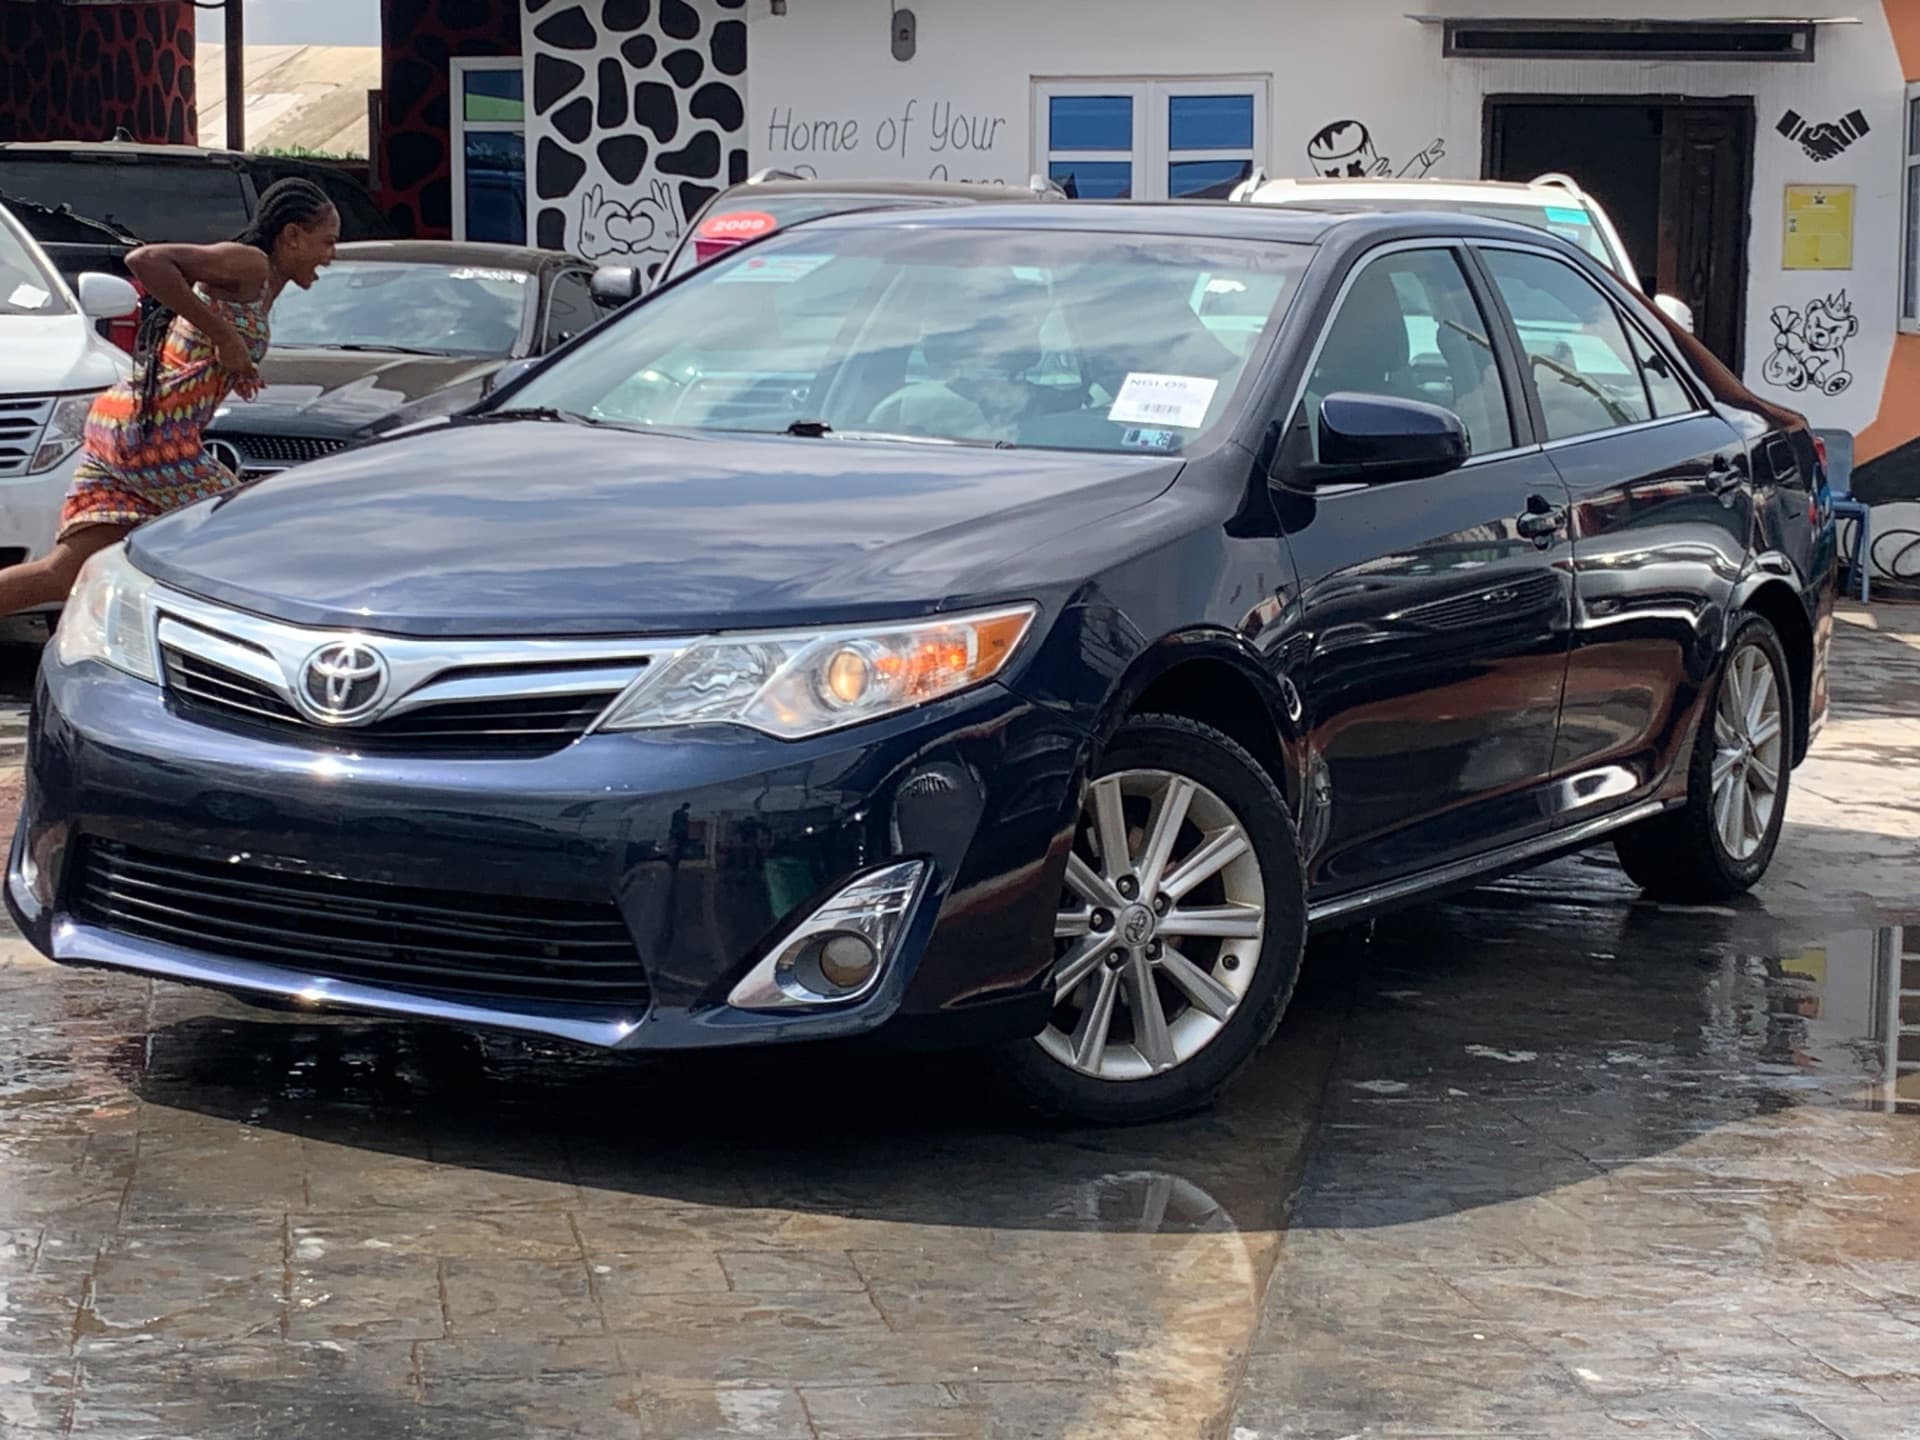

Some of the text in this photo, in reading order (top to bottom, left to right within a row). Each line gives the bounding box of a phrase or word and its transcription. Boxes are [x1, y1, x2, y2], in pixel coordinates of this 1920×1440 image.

[768, 99, 1006, 158] Home of Your
